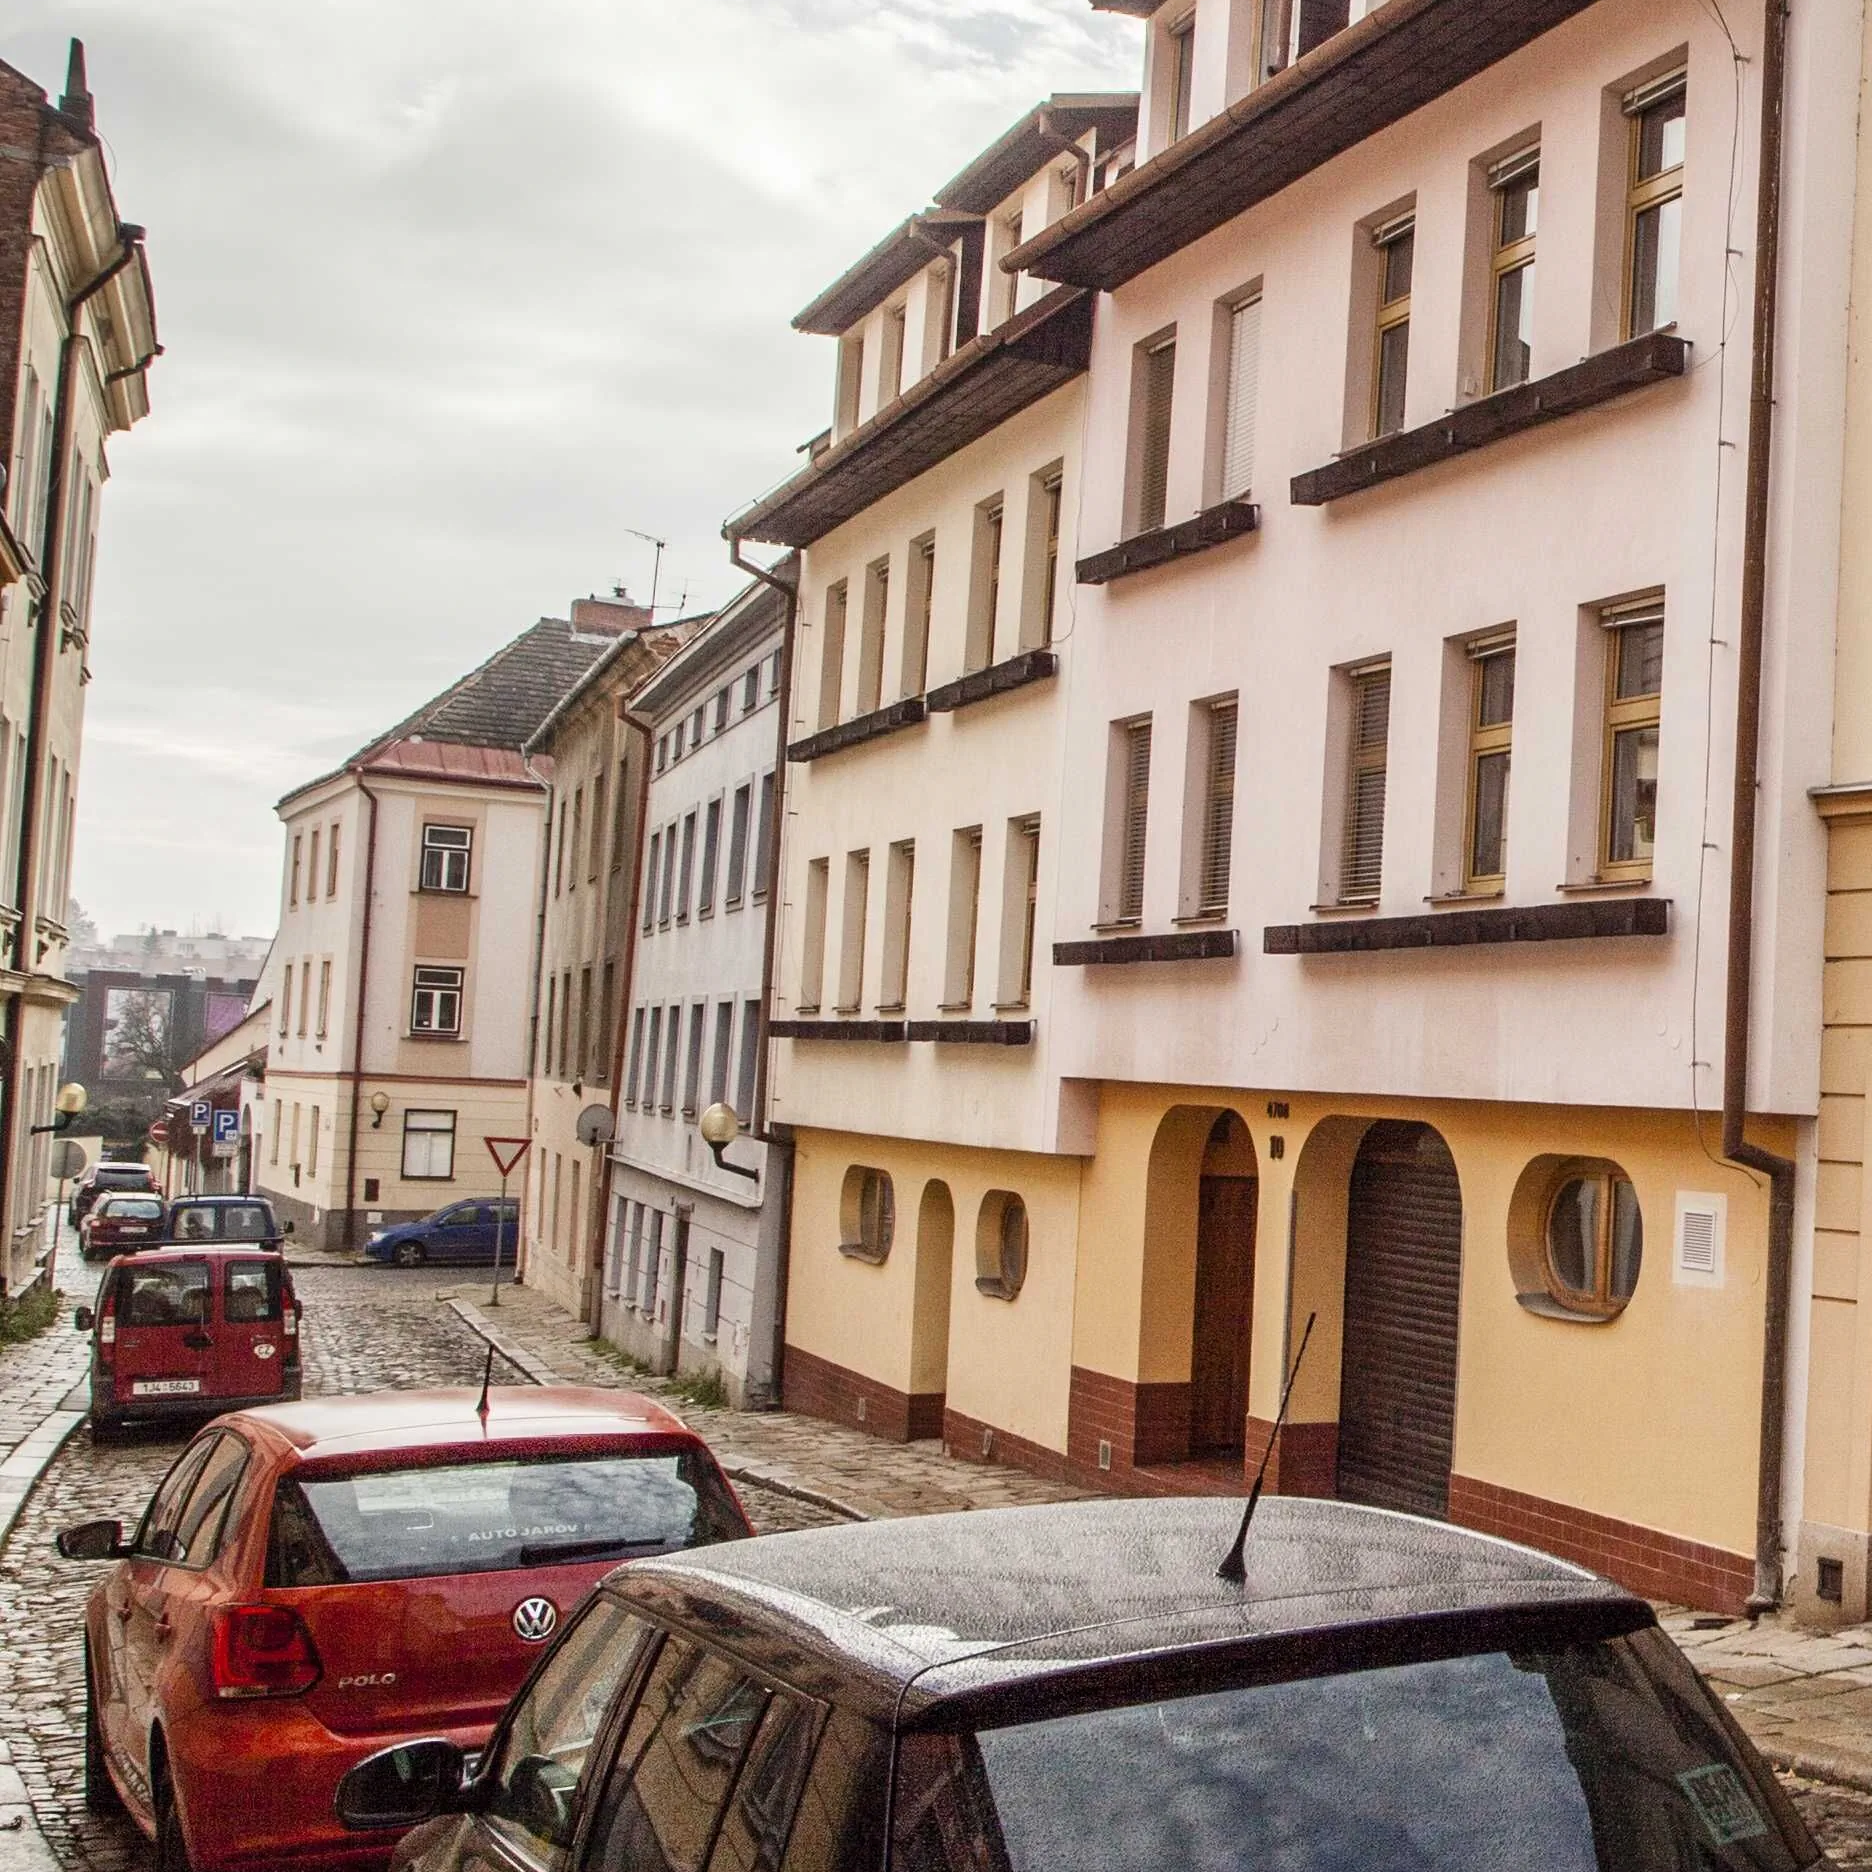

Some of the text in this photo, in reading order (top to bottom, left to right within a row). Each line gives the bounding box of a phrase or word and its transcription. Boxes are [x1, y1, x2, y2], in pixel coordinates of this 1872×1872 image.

[194, 1103, 207, 1119] P
[219, 1114, 234, 1133] P
[468, 1524, 578, 1542] AUTO JAROV
[338, 1672, 396, 1689] POLO
